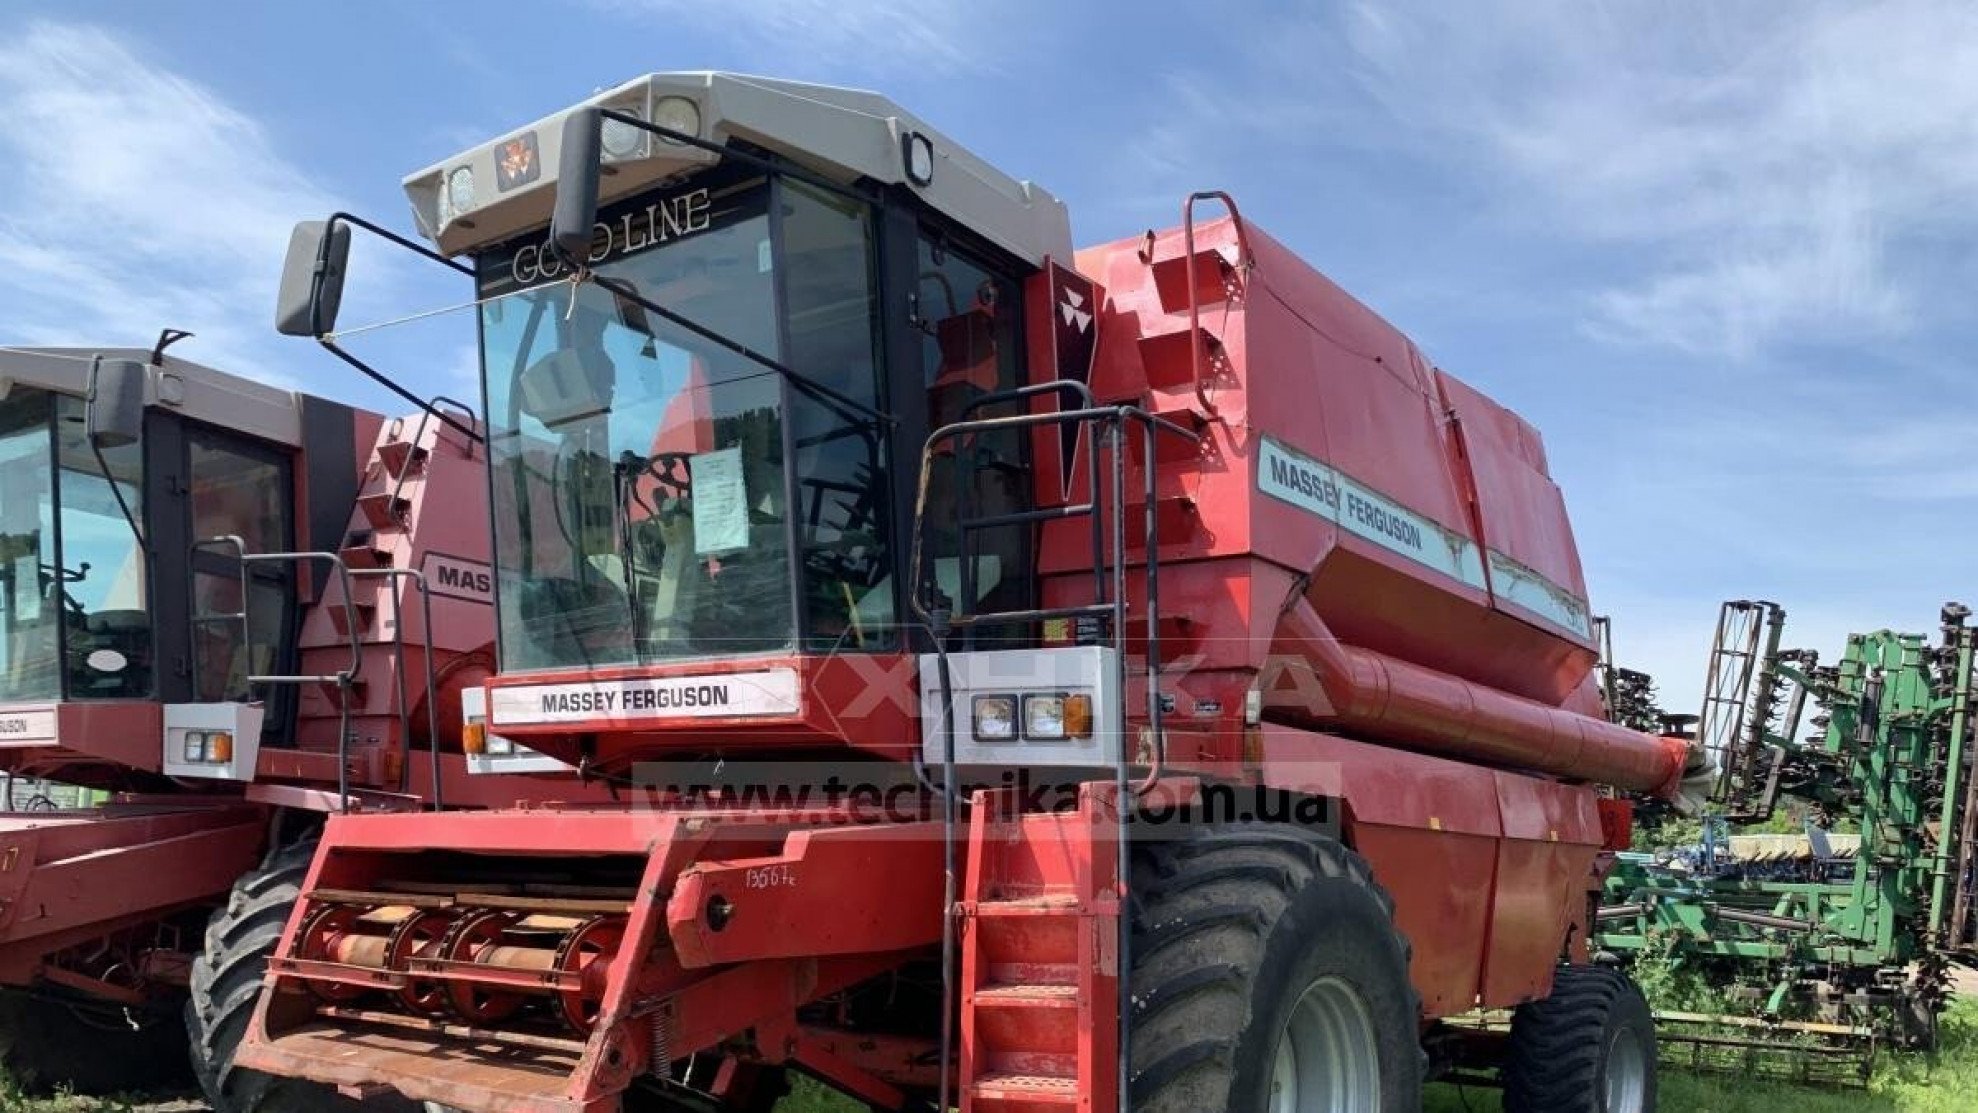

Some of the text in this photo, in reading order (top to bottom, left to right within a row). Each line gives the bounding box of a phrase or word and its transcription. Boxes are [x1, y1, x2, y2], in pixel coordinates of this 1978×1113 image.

[513, 187, 711, 283] GOD LINE
[1270, 454, 1423, 549] MASSEY FERGUSON
[541, 685, 728, 713] MASSEY FERGUSON
